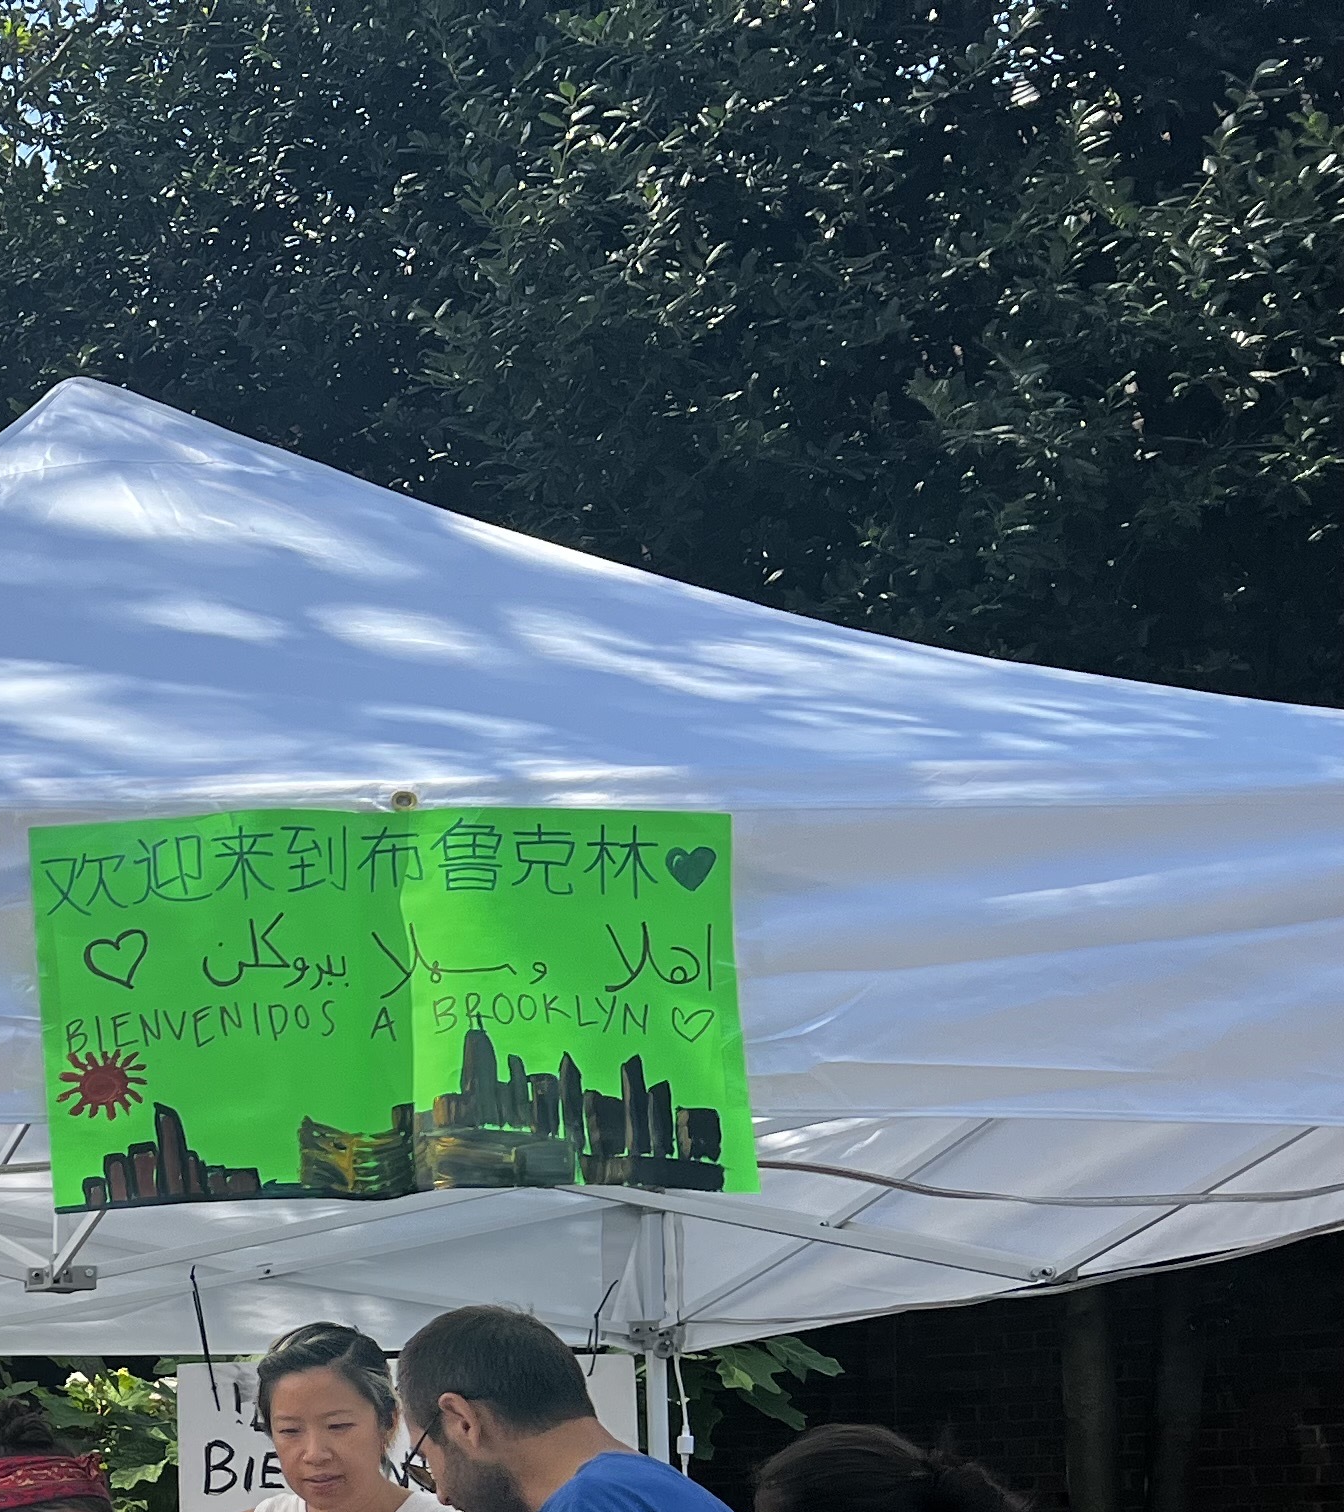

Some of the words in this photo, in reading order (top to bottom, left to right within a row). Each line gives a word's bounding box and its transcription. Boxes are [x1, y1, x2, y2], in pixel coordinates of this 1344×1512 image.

[40, 816, 661, 918] 欢迎来到布鲁克林
[64, 999, 337, 1055] BIENVENIDOS
[370, 1006, 398, 1041] A
[432, 992, 650, 1035] BROOKLYN
